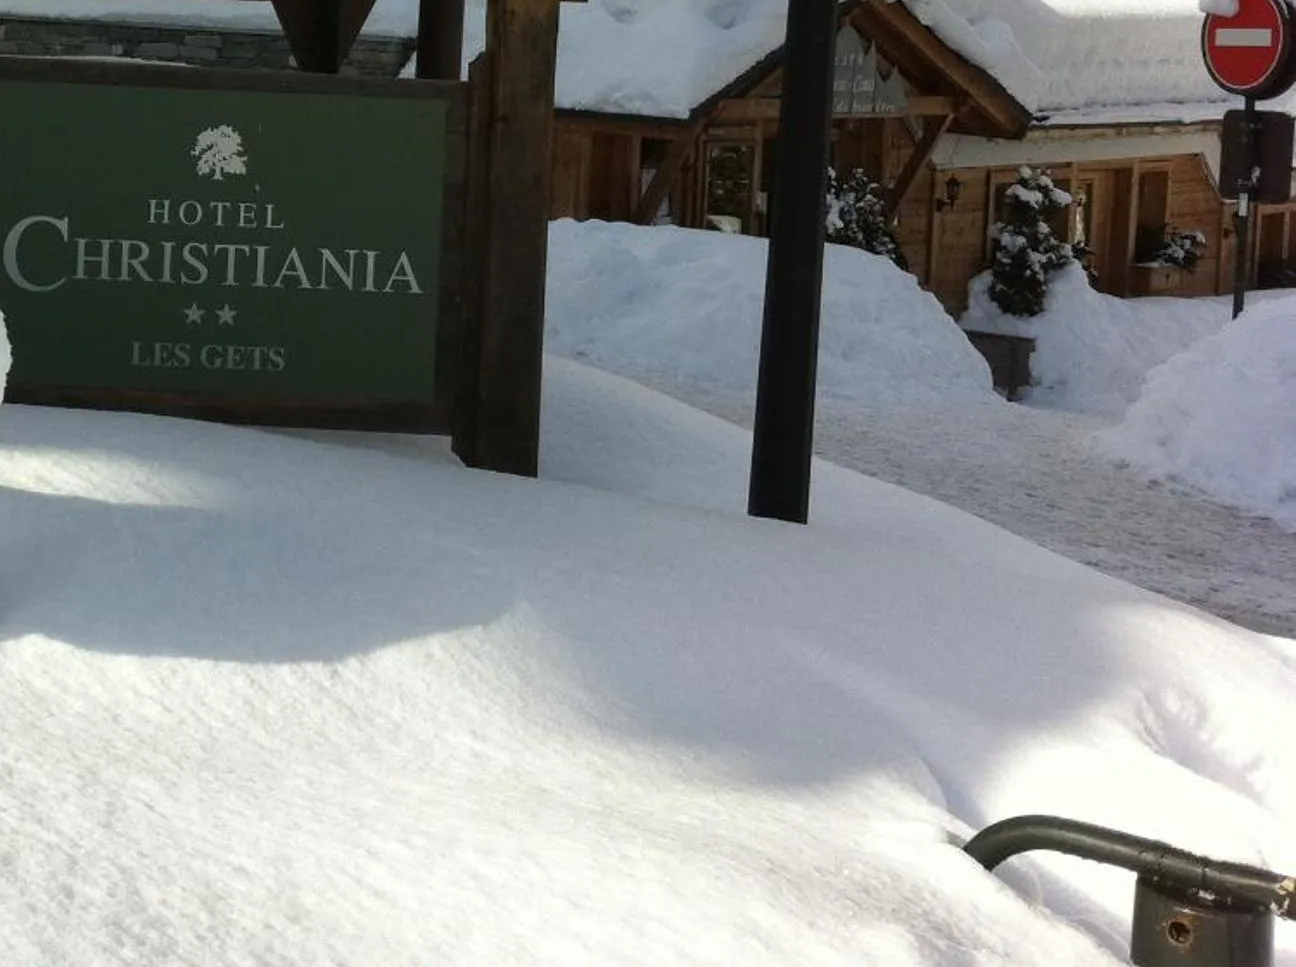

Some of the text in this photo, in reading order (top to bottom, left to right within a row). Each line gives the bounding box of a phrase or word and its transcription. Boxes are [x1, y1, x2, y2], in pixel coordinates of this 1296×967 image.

[148, 198, 285, 230] HOTEL
[3, 215, 424, 294] CHRISTIANIA
[131, 340, 286, 372] LES GETS
